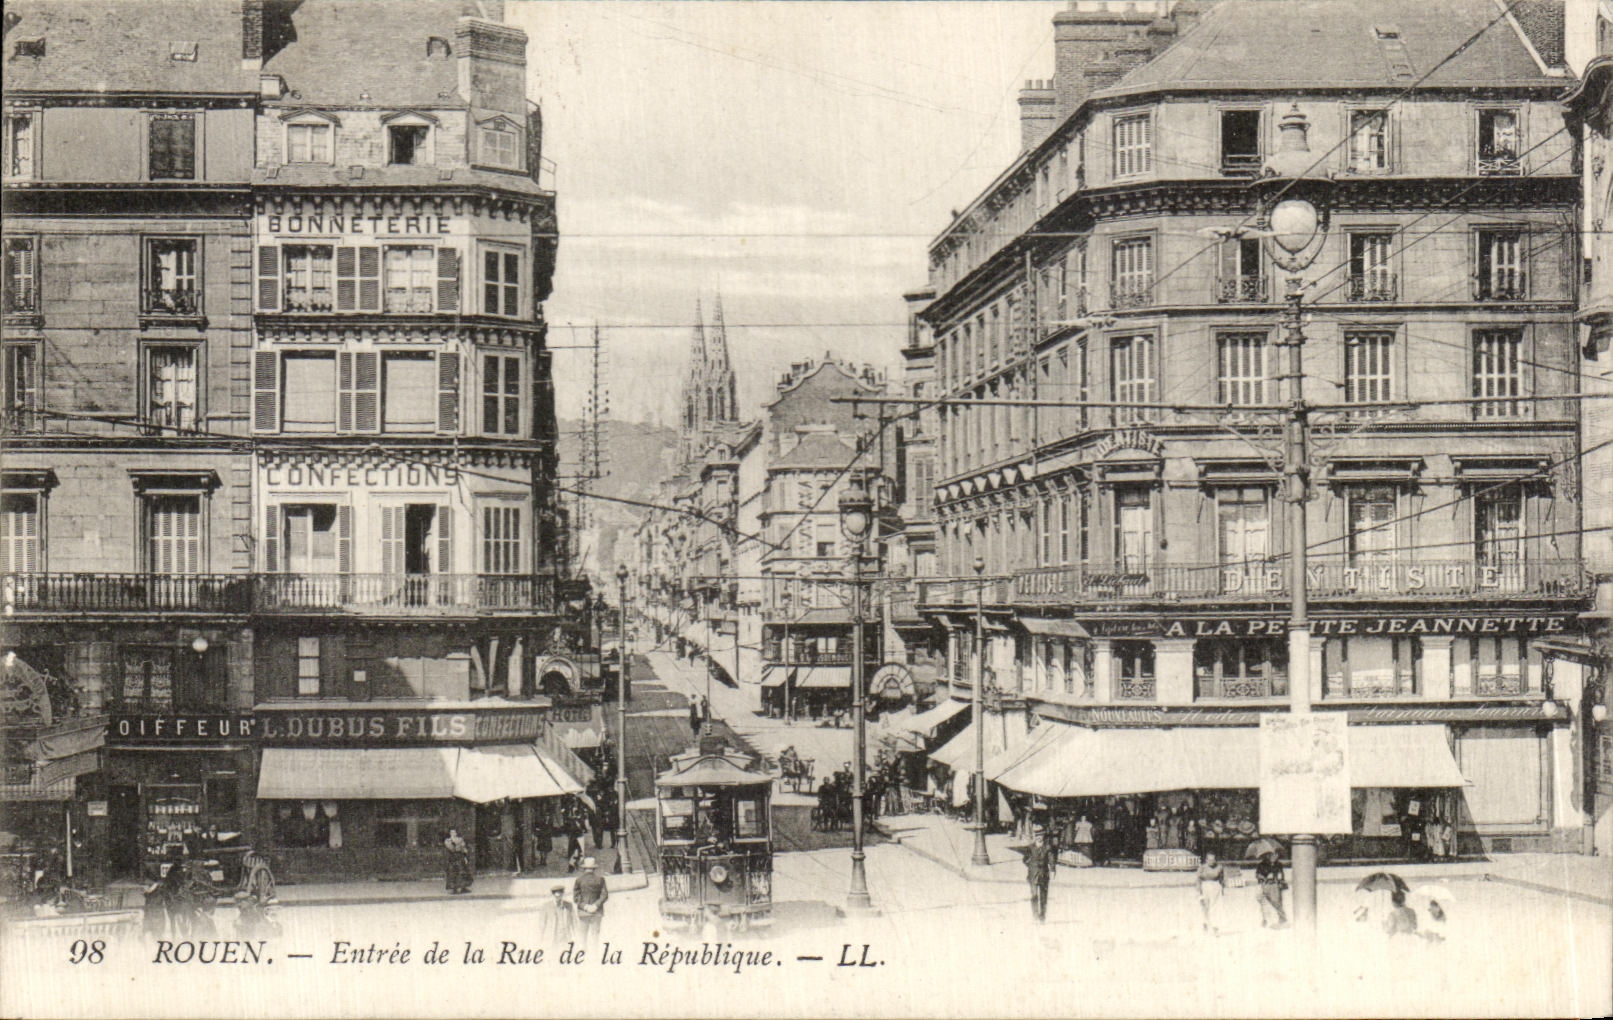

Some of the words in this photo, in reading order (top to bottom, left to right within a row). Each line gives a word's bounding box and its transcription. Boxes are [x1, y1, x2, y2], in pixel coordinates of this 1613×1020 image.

[268, 215, 451, 234] BONNETERIE
[266, 466, 459, 486] CONFECTIONS
[1222, 568, 1500, 591] DENTISTE
[1166, 621, 1186, 637] A
[1195, 621, 1235, 636] LA
[1247, 619, 1358, 635] PEITE
[1366, 617, 1565, 633] JEANNETTE
[399, 714, 466, 738] FILS
